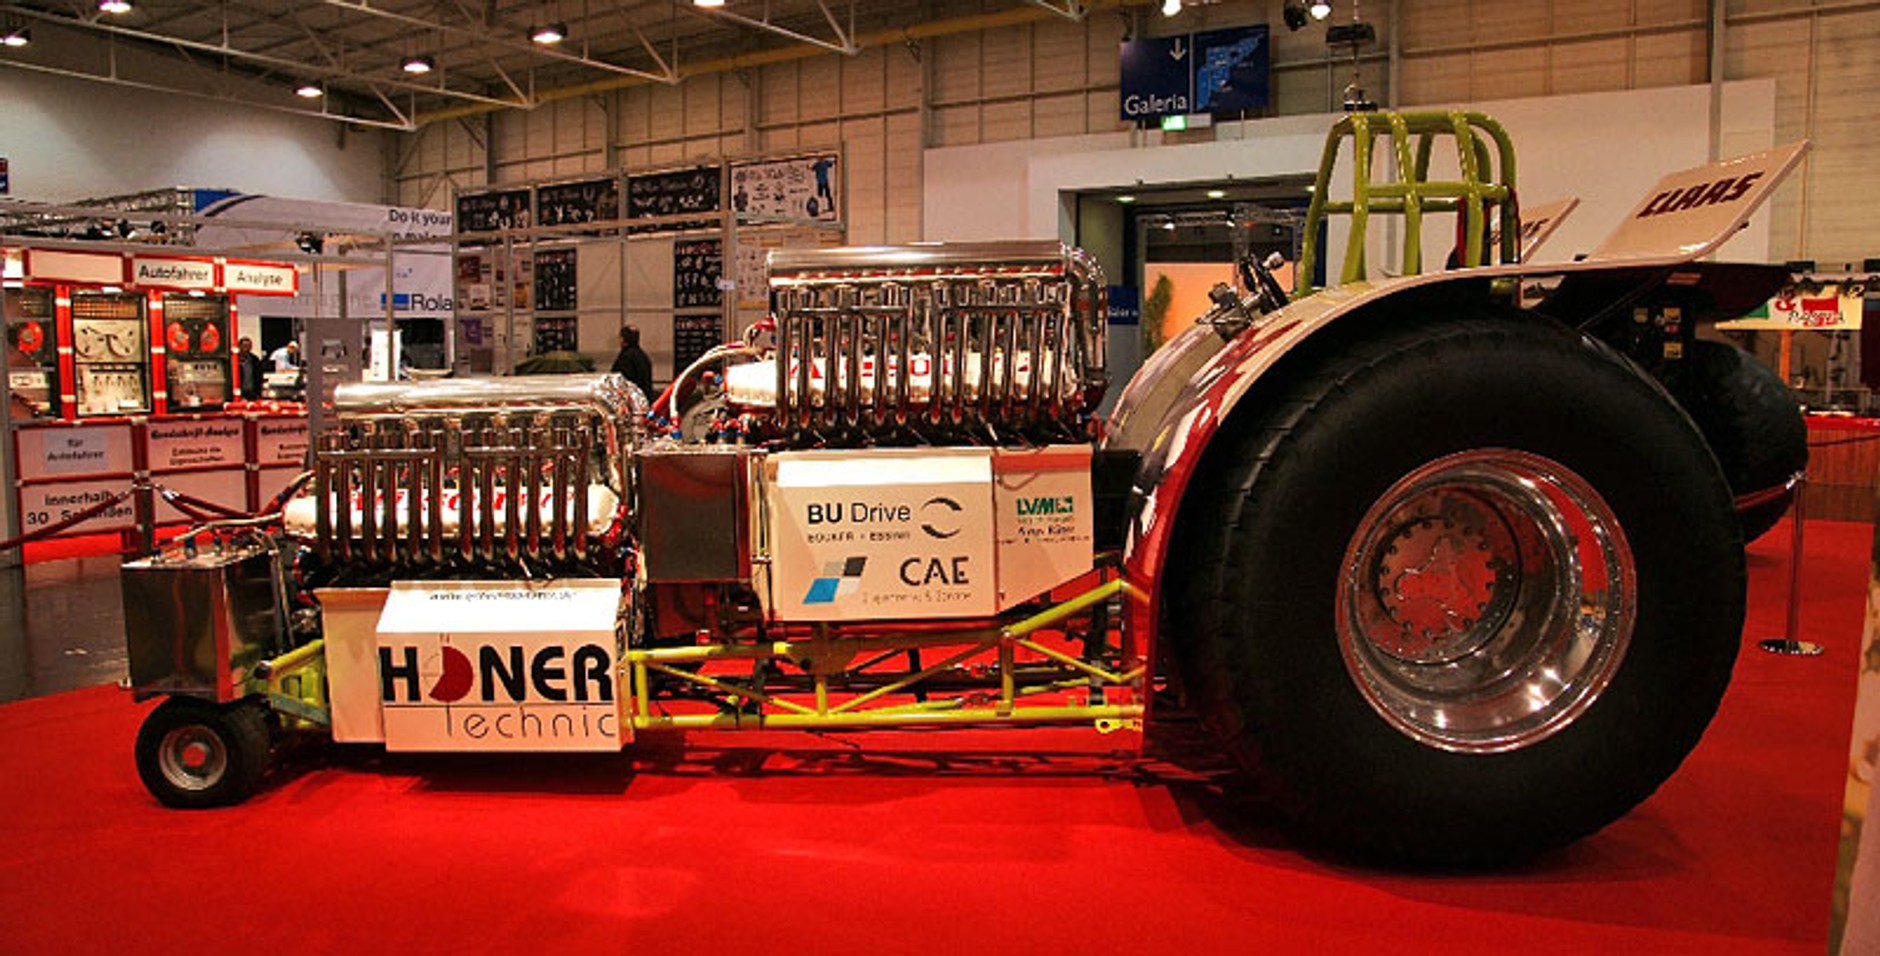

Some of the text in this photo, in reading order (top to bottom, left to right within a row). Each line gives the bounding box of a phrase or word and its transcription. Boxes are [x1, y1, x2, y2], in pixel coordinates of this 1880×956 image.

[1124, 93, 1188, 115] Galeria
[1636, 171, 1764, 219] CLAAS
[388, 209, 451, 227] Do it your
[138, 265, 208, 280] Autofahrer
[236, 270, 283, 287] Analyse
[411, 294, 452, 311] Rola
[47, 450, 104, 461] Autofahrer
[808, 502, 911, 524] BU Drive
[1017, 498, 1054, 515] LVM
[27, 511, 49, 525] 30
[899, 556, 969, 586] CAE
